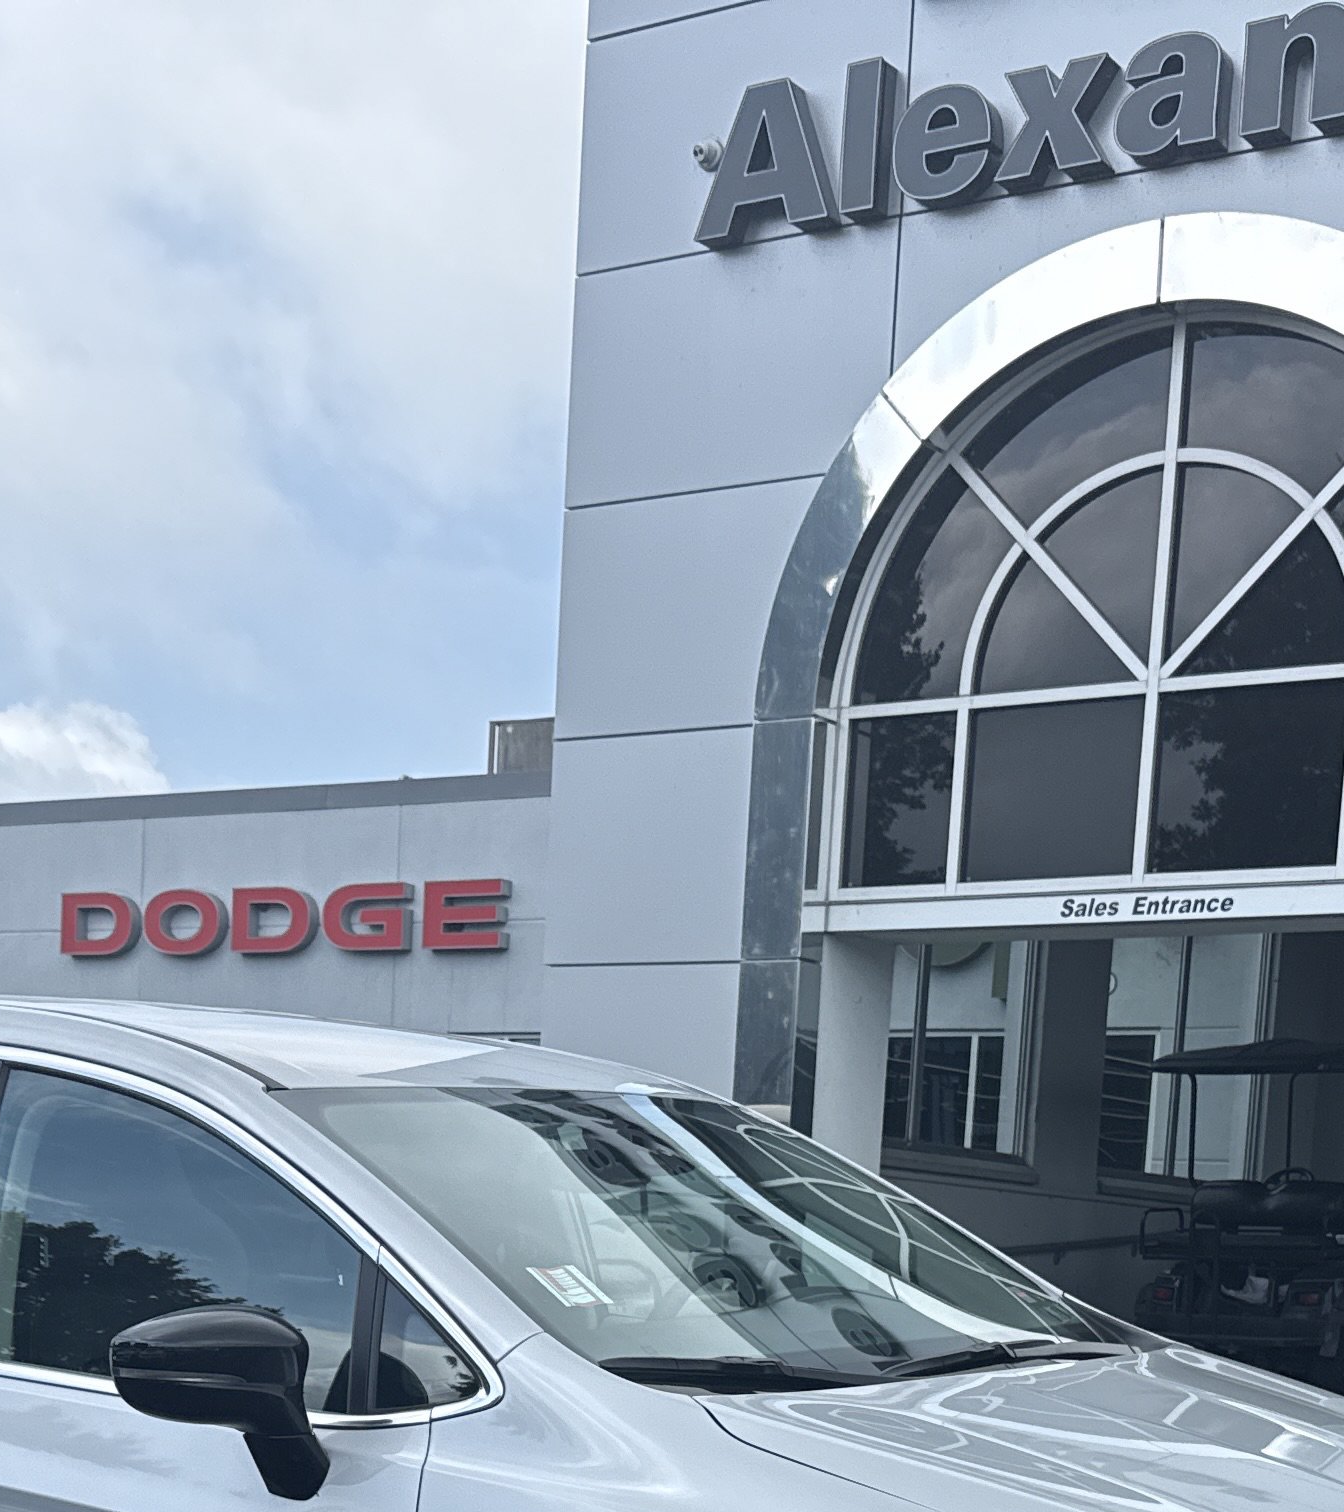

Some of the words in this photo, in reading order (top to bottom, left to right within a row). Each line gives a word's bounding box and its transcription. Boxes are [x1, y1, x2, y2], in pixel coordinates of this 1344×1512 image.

[60, 879, 512, 957] DODGE
[1060, 899, 1119, 918] Sales
[1132, 896, 1234, 915] Entrance
